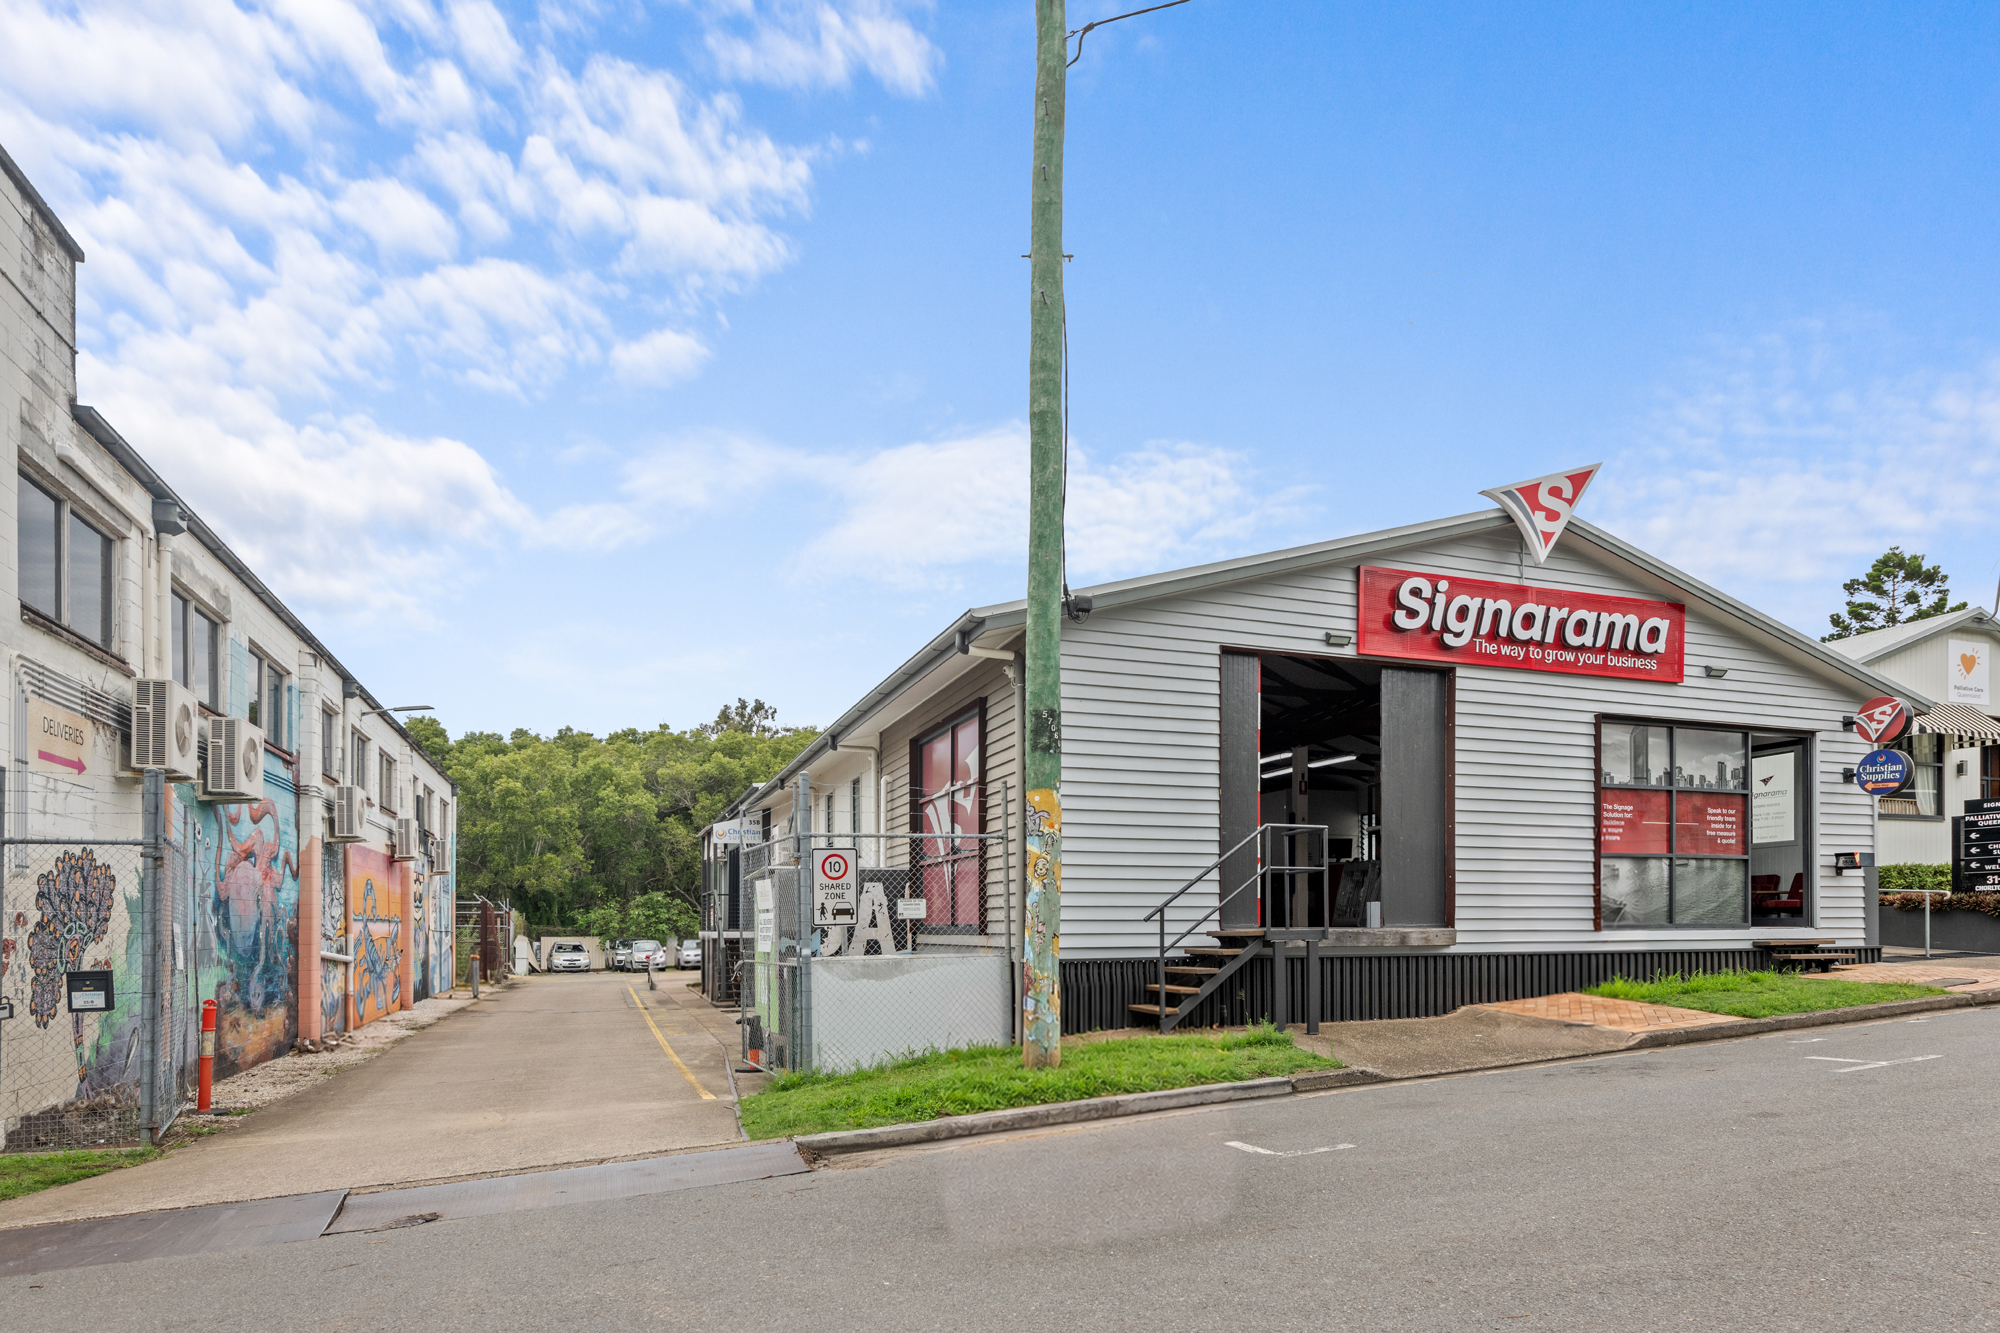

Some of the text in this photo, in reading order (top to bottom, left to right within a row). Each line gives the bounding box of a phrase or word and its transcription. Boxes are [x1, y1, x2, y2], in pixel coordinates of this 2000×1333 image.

[1393, 577, 1670, 653] Signarama
[1473, 639, 1657, 670] The way to grow your business
[43, 716, 84, 746] DELIVERIES
[1860, 763, 1902, 774] Christian
[1860, 772, 1900, 782] Supplies
[828, 861, 841, 873] 10
